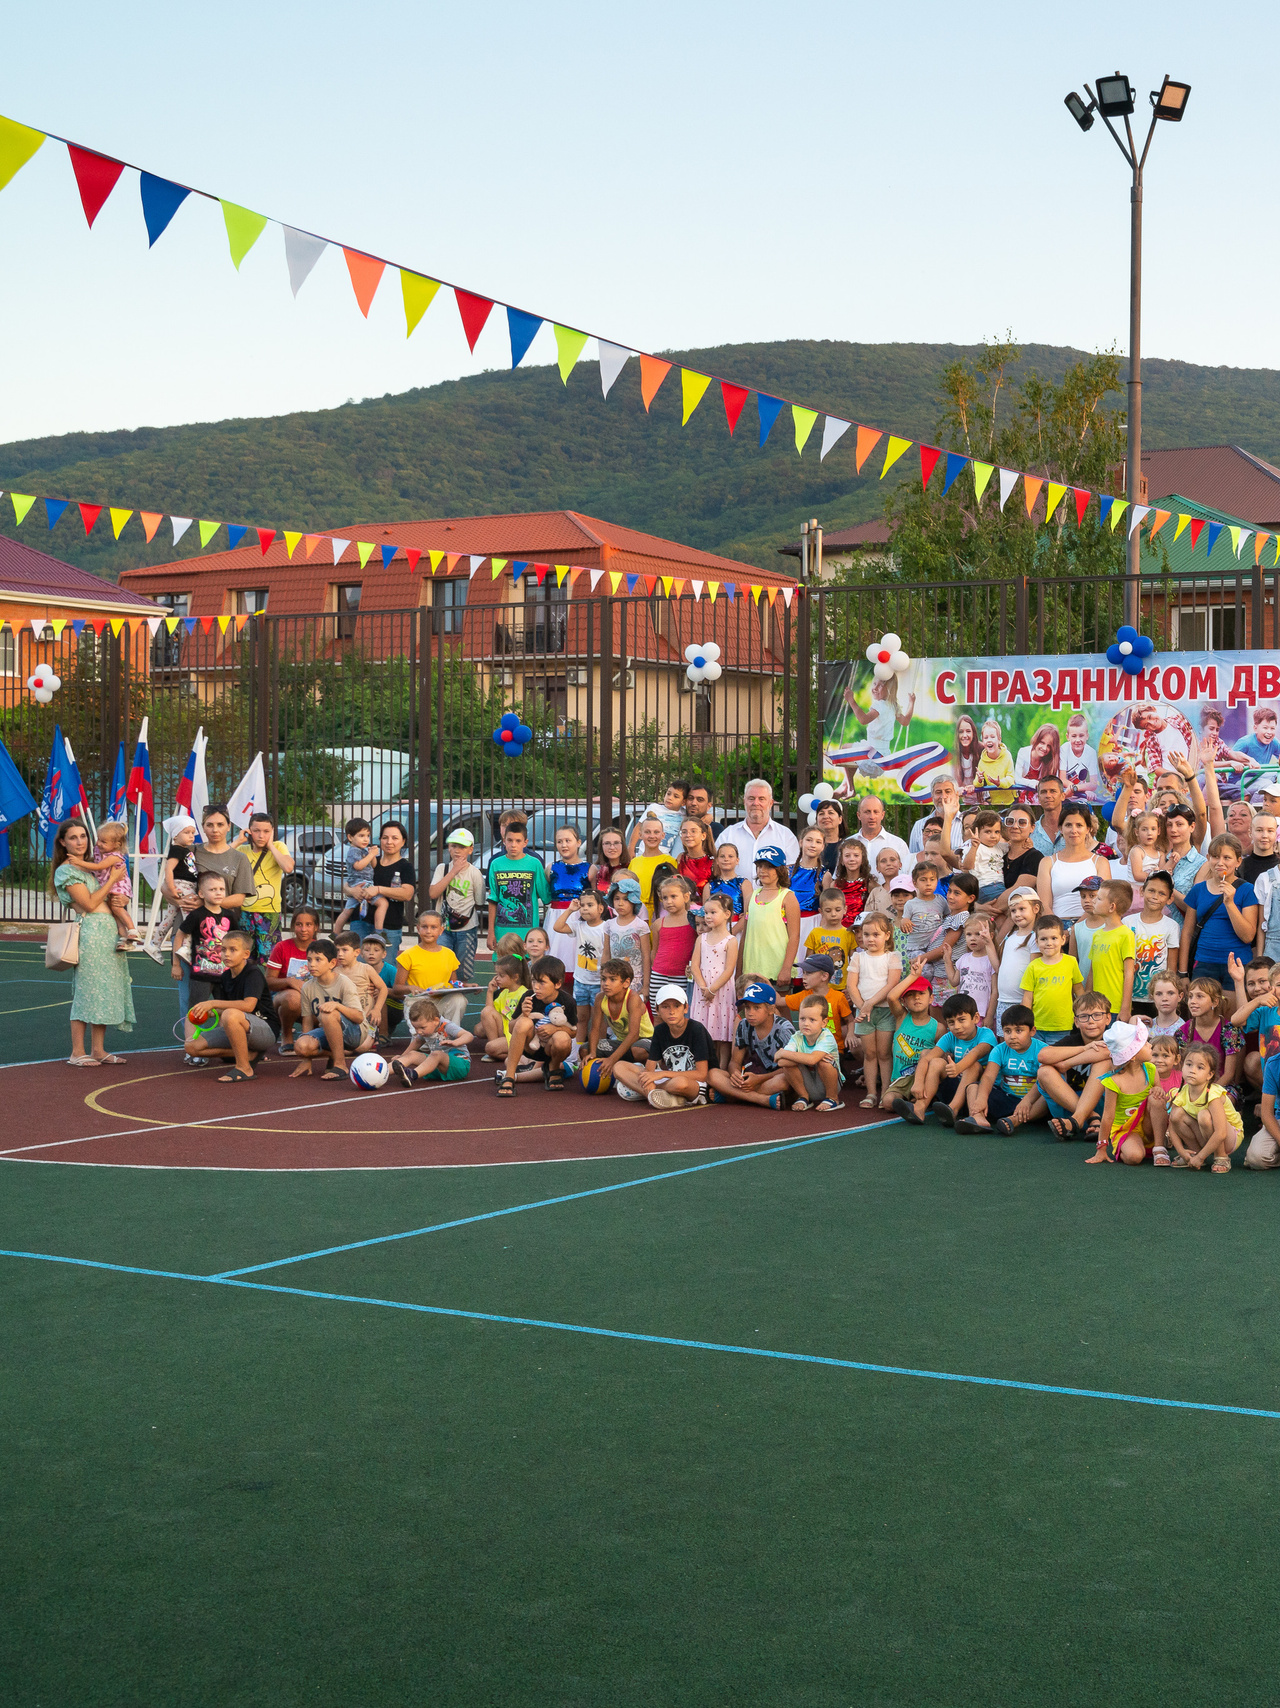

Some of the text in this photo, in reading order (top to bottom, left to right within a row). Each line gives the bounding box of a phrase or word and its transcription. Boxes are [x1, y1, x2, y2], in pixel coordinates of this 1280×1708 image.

[936, 671, 957, 705] С
[966, 666, 1218, 710] ПРАЗДНИКОМ
[821, 936, 841, 944] BORN
